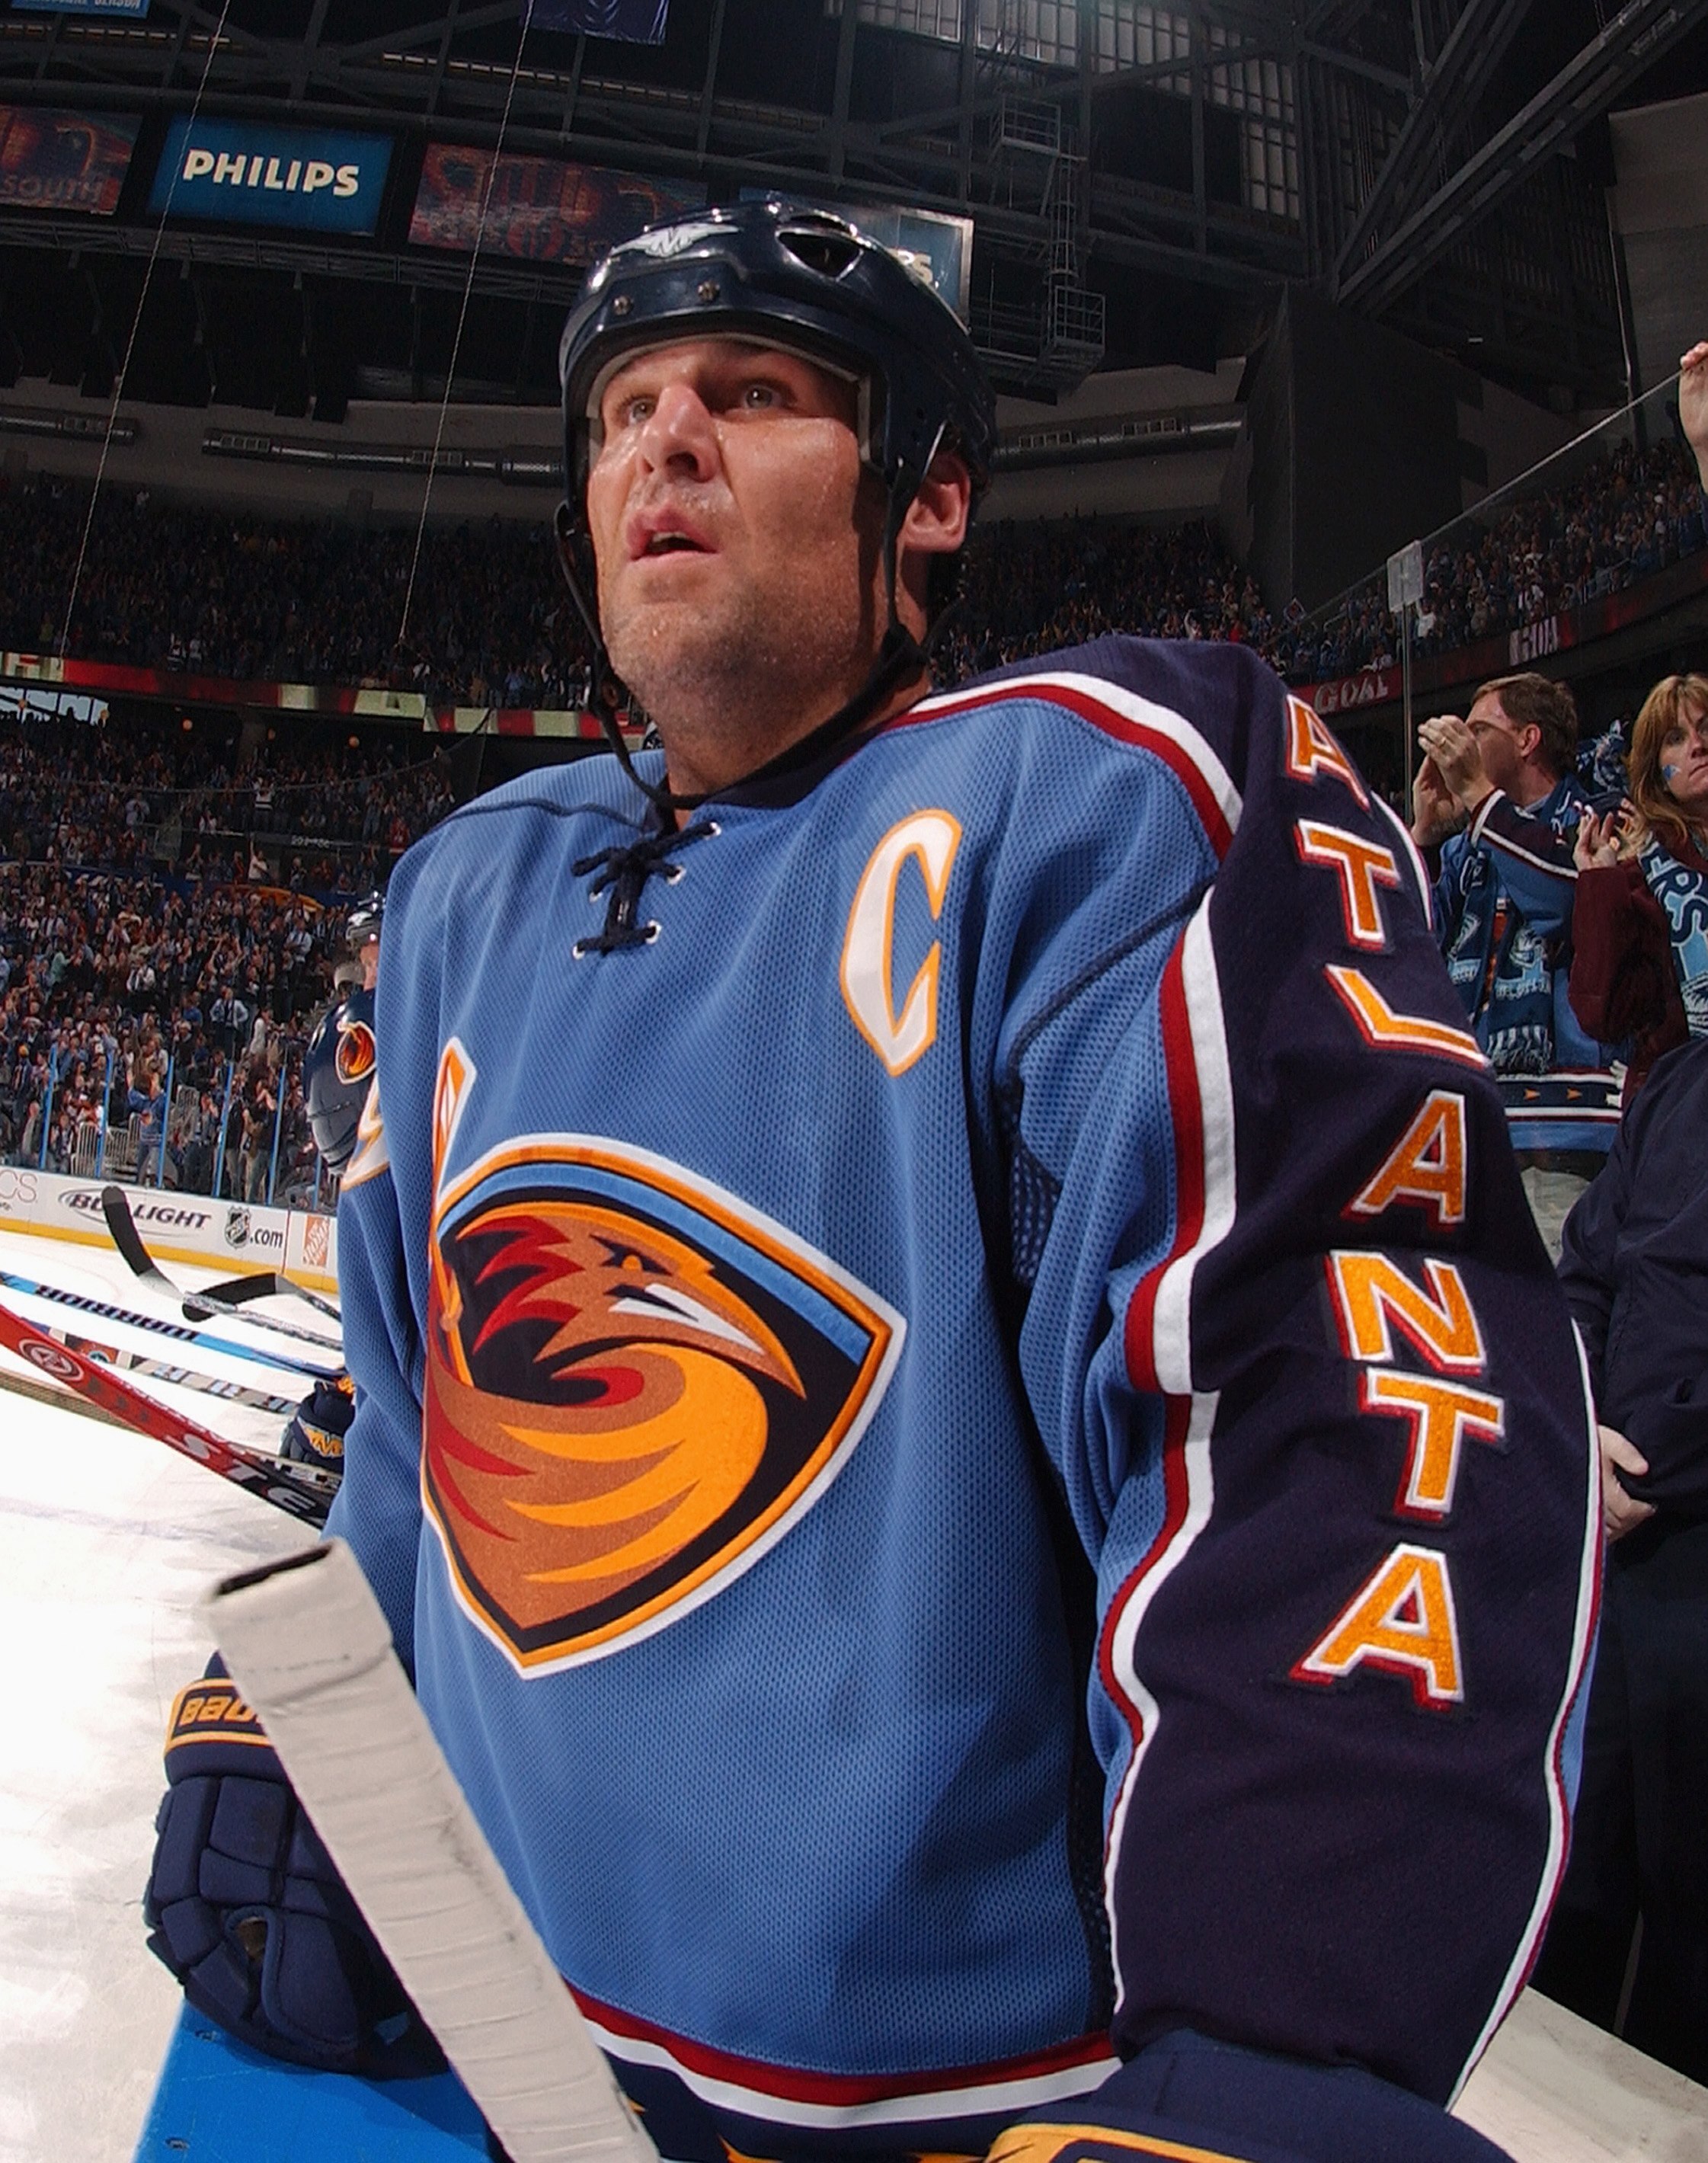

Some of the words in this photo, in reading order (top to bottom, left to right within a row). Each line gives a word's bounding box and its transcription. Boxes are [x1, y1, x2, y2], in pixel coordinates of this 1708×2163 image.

[183, 149, 360, 197] PHILIPS
[1314, 675, 1389, 715] GOAL
[839, 808, 963, 1077] C
[133, 1204, 211, 1228] LIGHT
[1285, 694, 1505, 1711] ATLANTA
